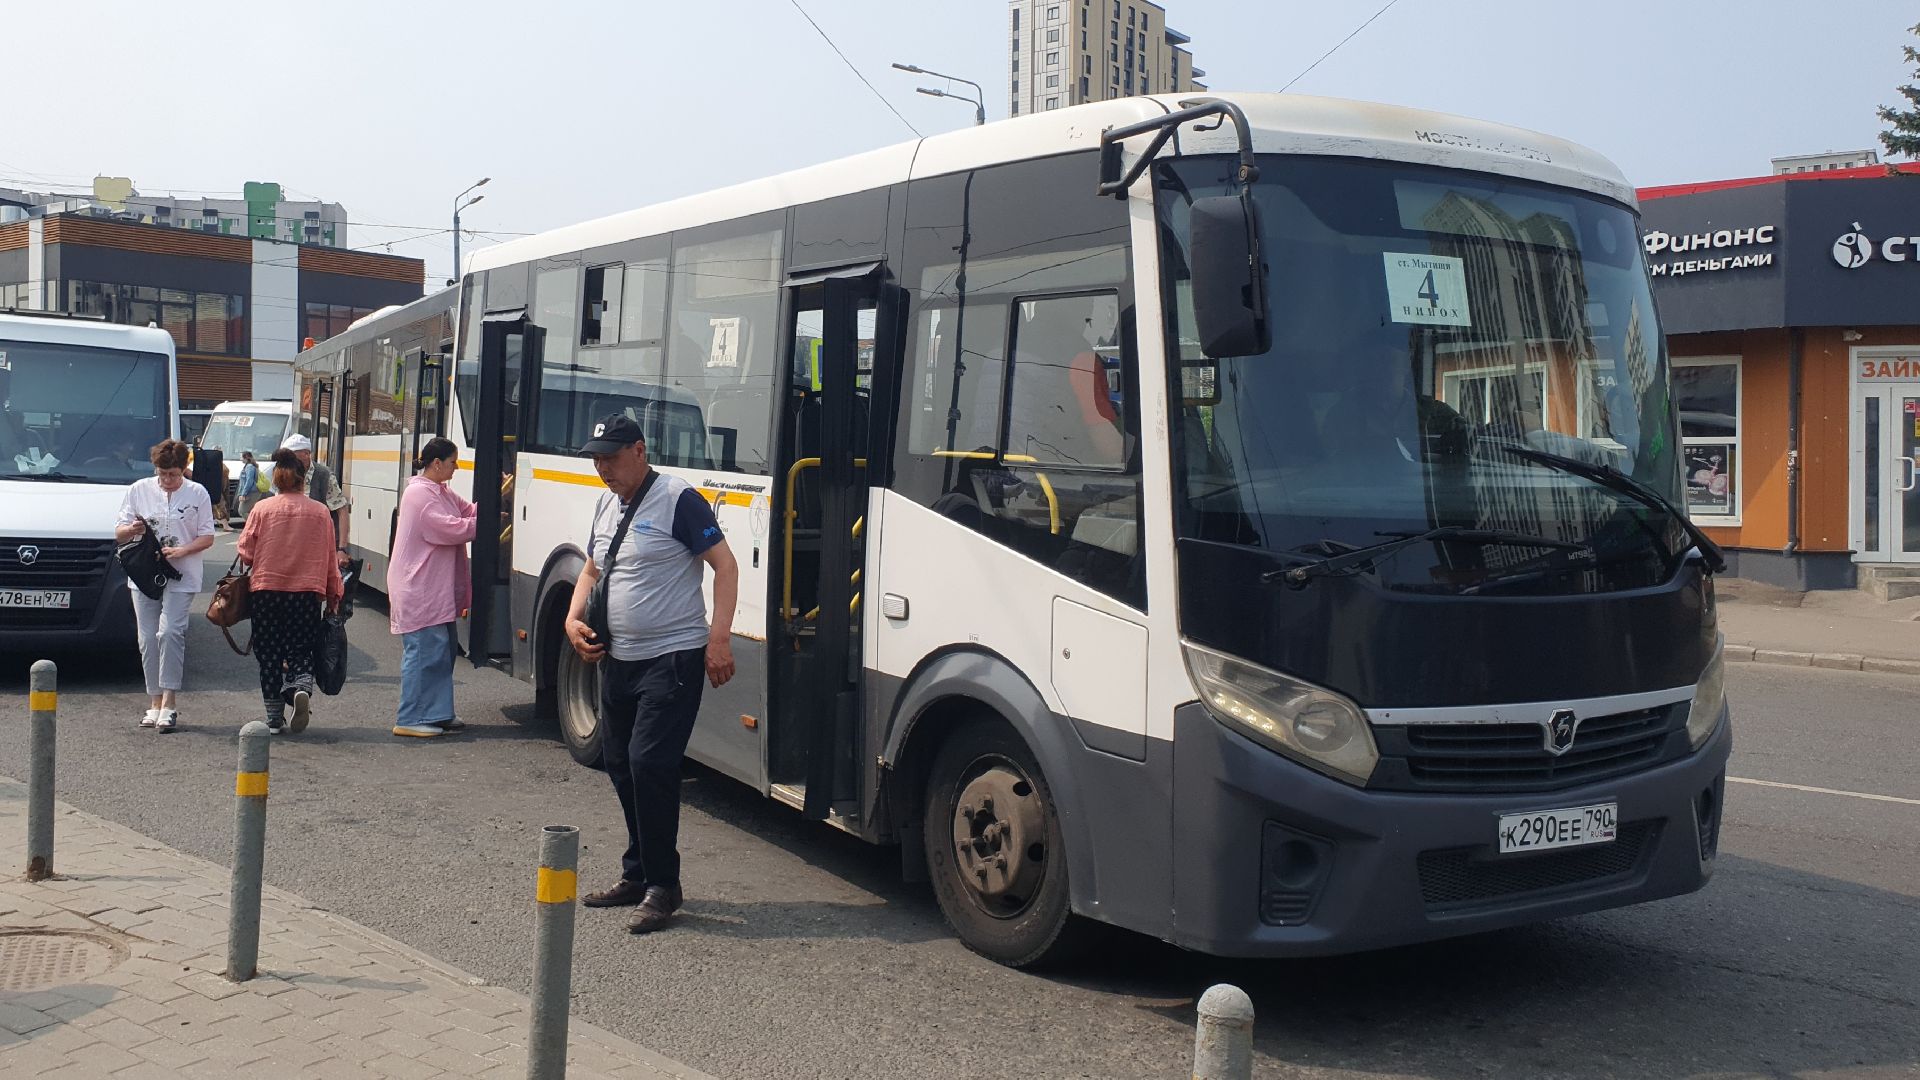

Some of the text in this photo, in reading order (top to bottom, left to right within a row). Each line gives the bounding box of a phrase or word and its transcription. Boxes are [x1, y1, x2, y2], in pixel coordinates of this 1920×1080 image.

[1643, 225, 1774, 255] Финанс
[1397, 259, 1451, 270] ст. Мытищи
[1670, 253, 1772, 277] ДЕНЬГАМИ
[1418, 269, 1440, 308] 4
[718, 328, 727, 355] 4
[45, 592, 66, 603] 977
[1506, 808, 1612, 849] К290ЕЕ 790
[1590, 830, 1603, 838] RUS
